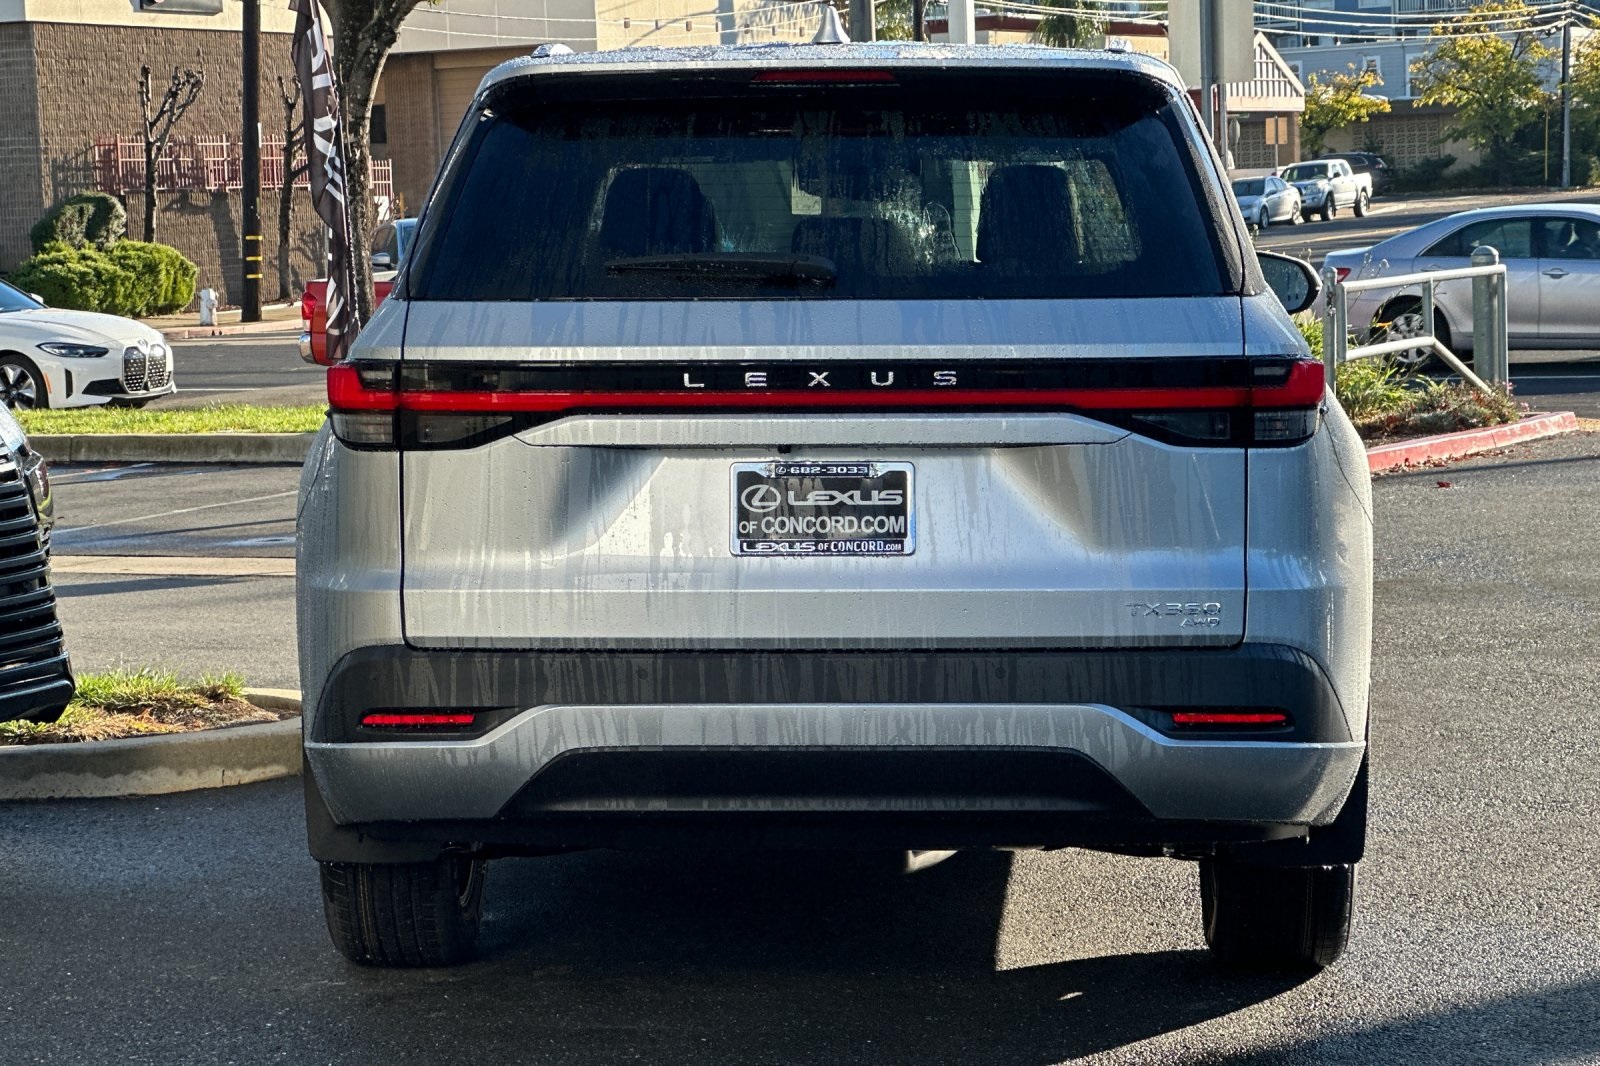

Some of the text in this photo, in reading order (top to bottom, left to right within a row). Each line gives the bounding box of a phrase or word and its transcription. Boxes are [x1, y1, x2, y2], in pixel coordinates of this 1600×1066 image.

[683, 370, 957, 388] LEXUS
[788, 490, 903, 506] LEXUS
[738, 515, 905, 534] OF CONCORD.COM
[742, 541, 816, 552] LEXUS
[817, 542, 829, 551] OF
